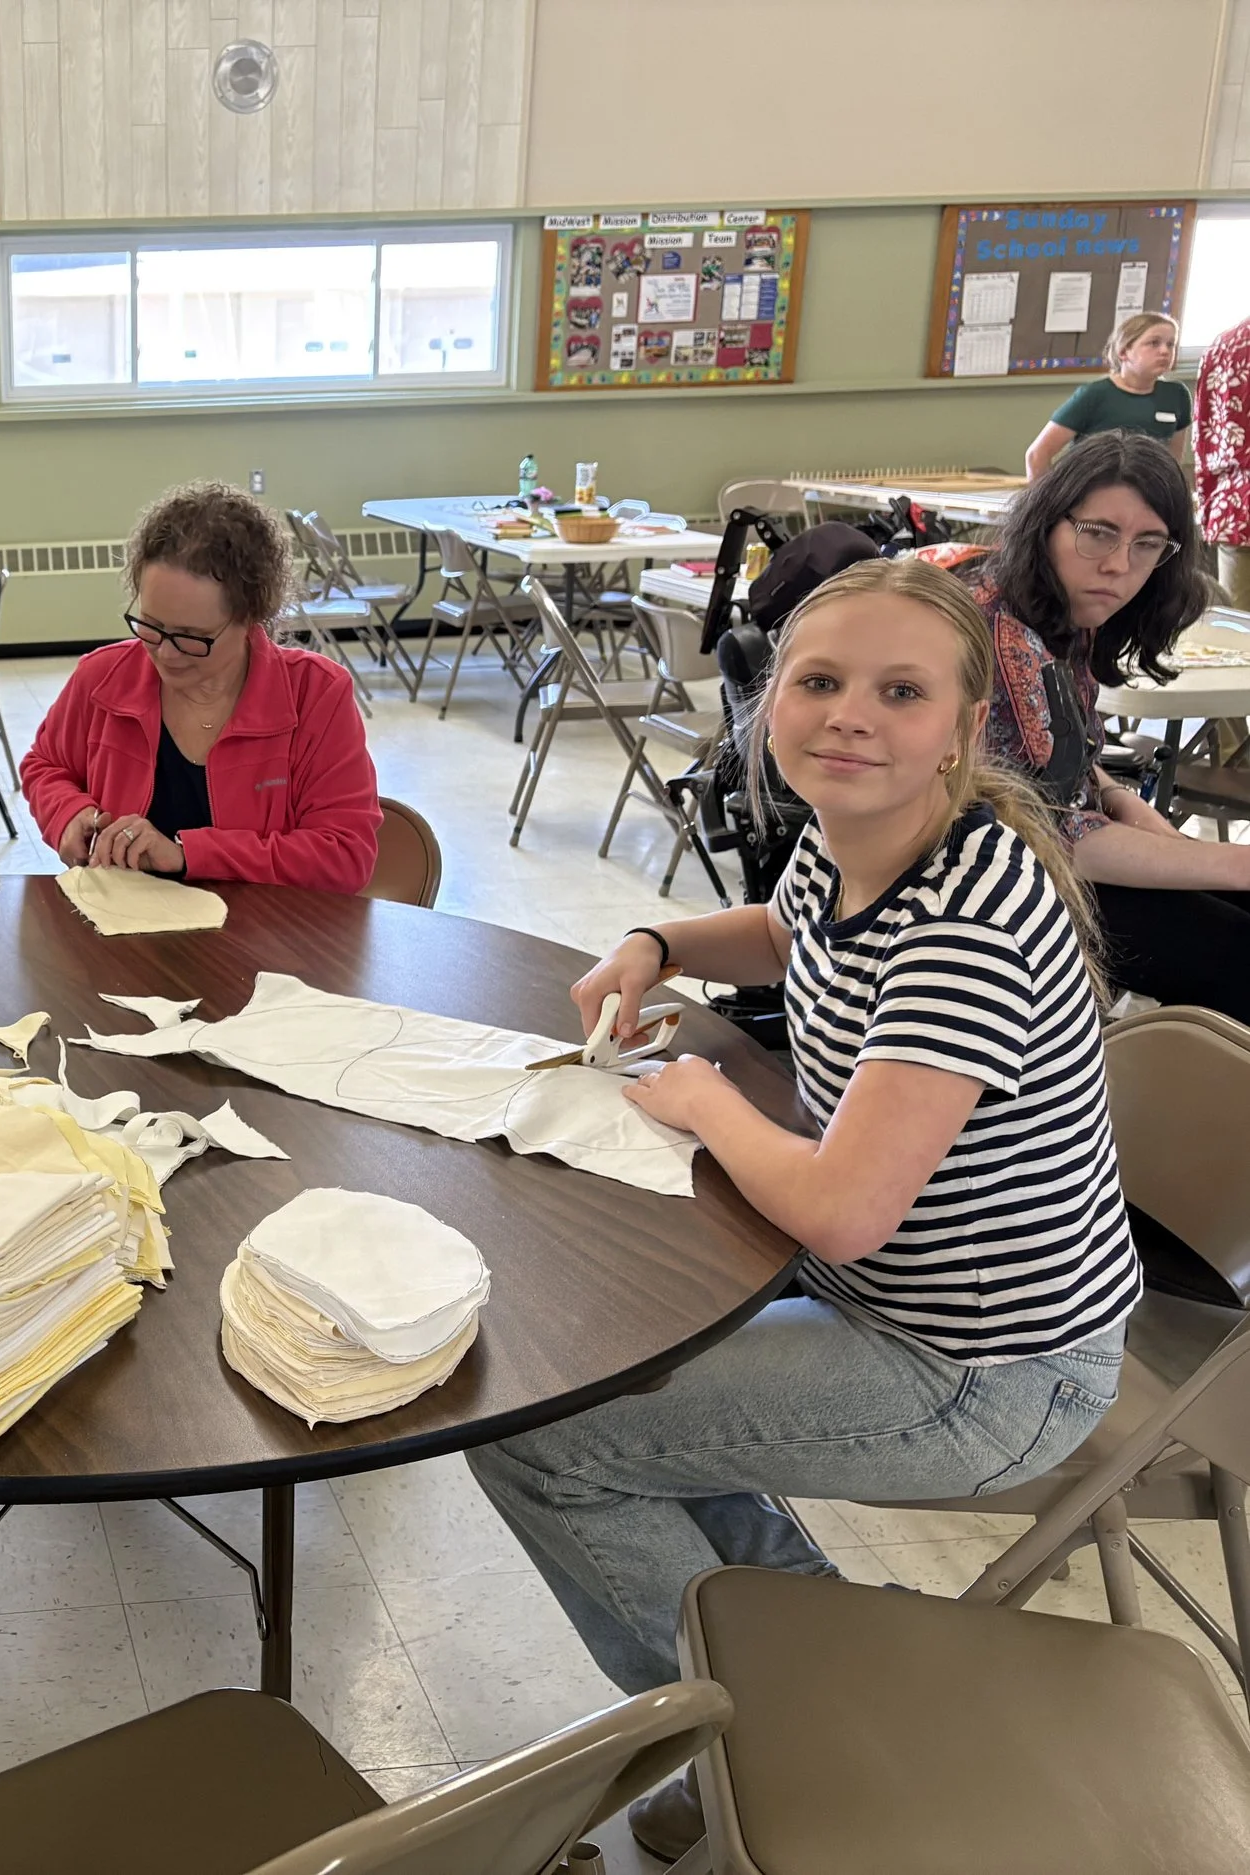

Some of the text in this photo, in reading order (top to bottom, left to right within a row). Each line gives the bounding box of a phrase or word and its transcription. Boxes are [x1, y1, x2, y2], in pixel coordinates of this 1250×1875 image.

[602, 216, 638, 226] Mission
[651, 213, 709, 224] Distribution
[726, 213, 759, 223] Center
[1005, 209, 1108, 235] Sunday
[647, 233, 733, 246] Mission Team
[977, 236, 1141, 262] School news
